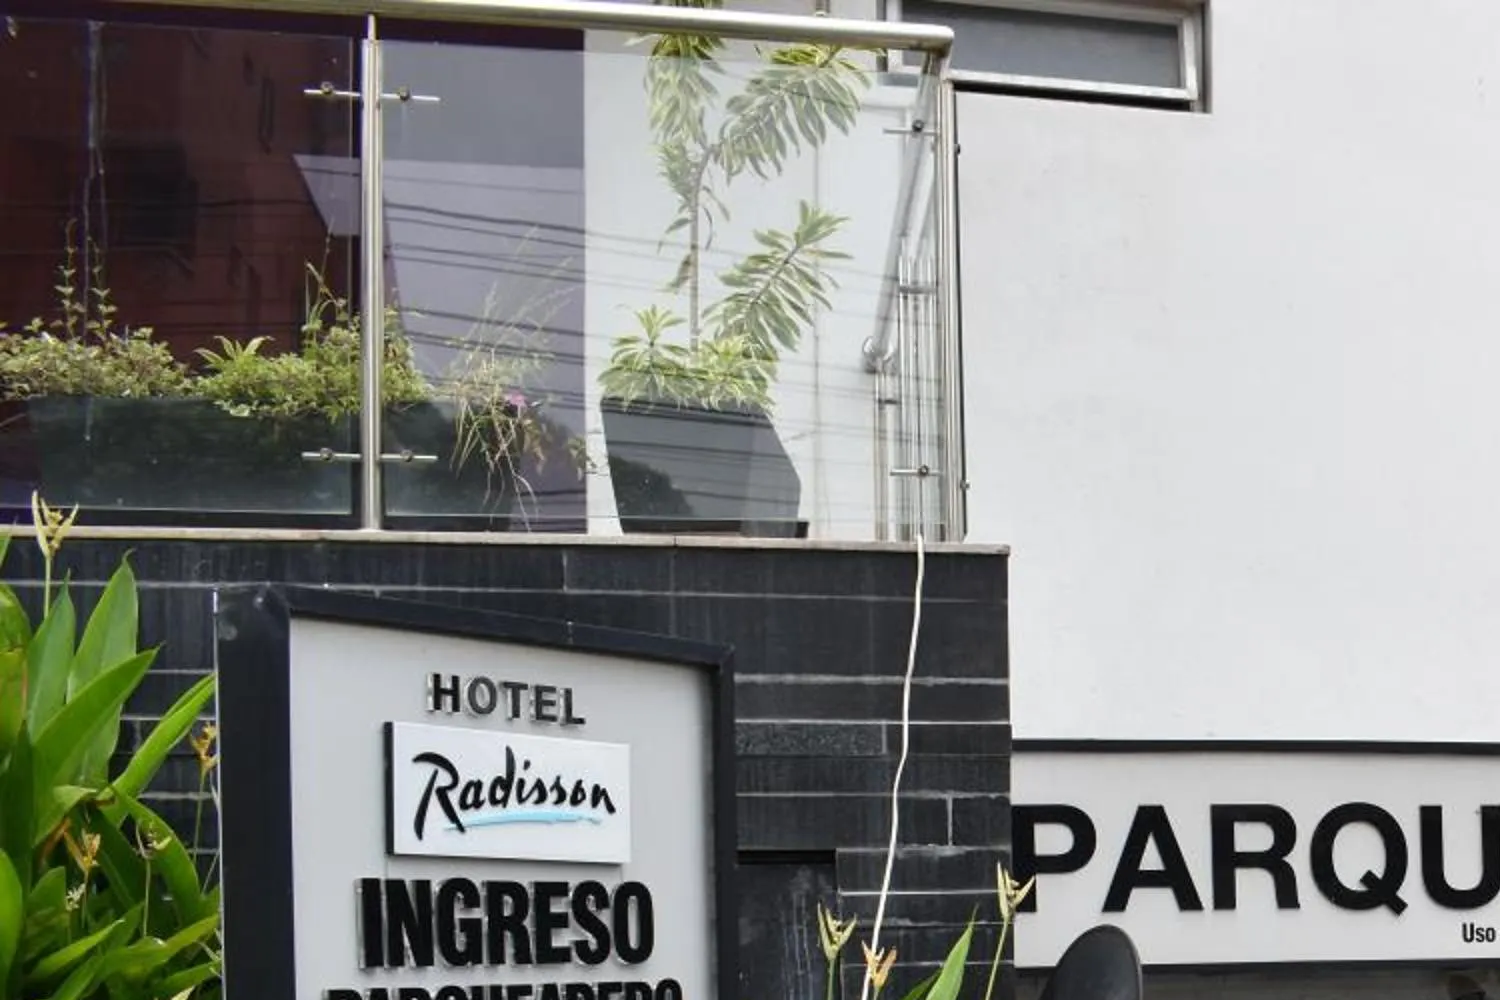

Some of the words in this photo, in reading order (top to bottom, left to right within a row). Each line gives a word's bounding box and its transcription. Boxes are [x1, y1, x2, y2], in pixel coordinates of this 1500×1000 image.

[428, 673, 586, 725] HOTEL
[412, 745, 617, 840] Radisson
[357, 877, 655, 969] INGRESO
[1462, 922, 1496, 943] Uso
